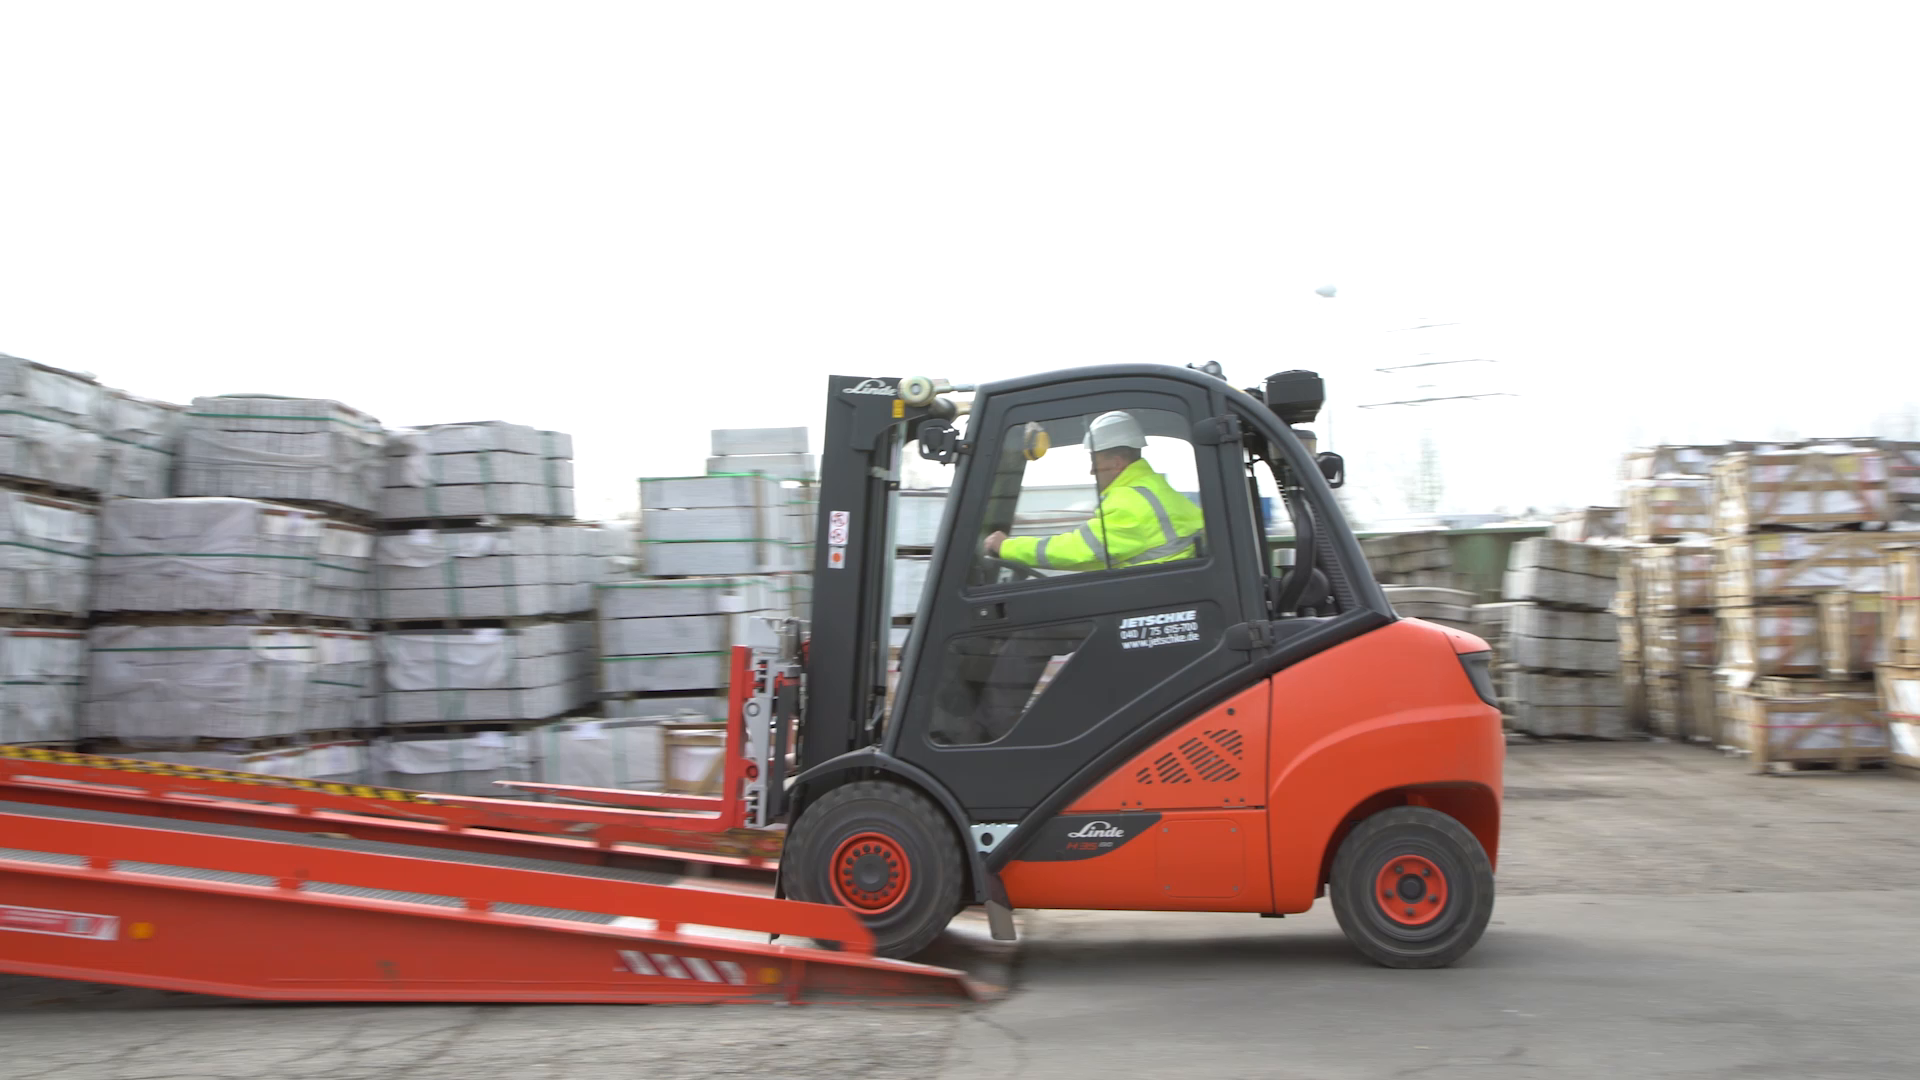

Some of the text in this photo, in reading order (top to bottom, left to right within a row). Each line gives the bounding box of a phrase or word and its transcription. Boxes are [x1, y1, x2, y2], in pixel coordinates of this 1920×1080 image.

[842, 379, 897, 397] Linde
[1119, 610, 1197, 629] JETSCHKE
[1121, 632, 1200, 650] www.jetschke.de
[1067, 820, 1125, 838] Linde
